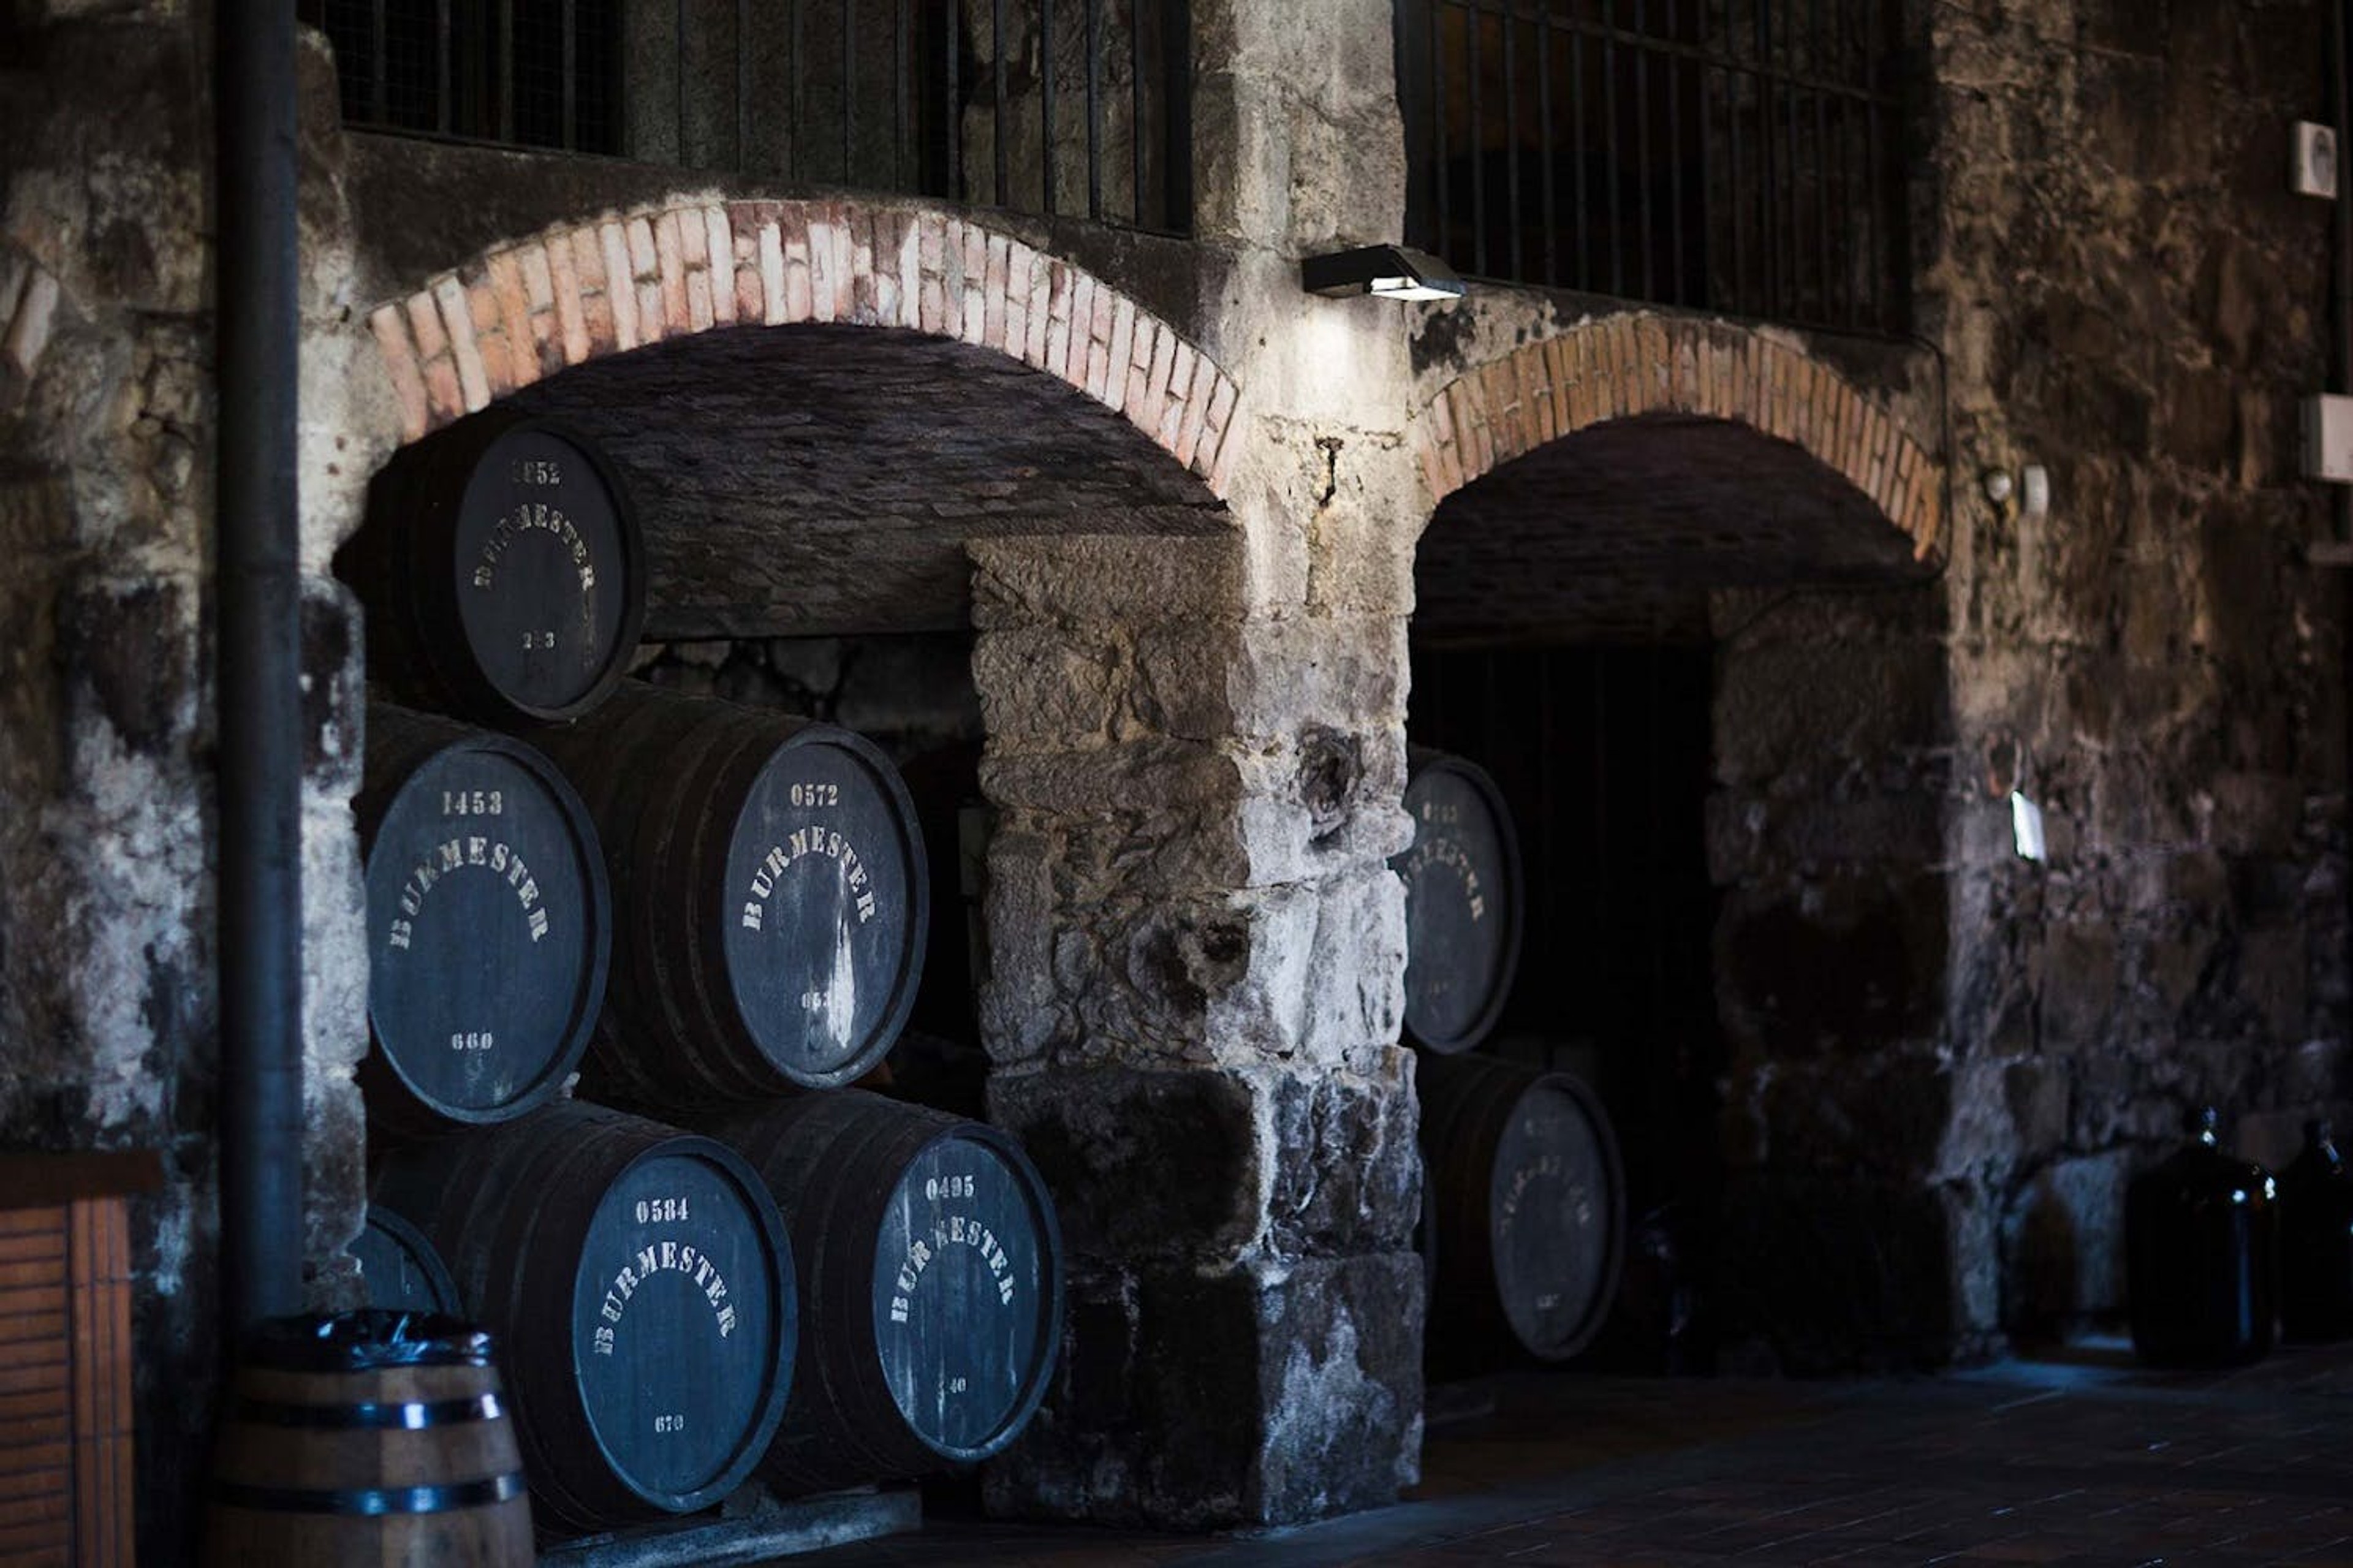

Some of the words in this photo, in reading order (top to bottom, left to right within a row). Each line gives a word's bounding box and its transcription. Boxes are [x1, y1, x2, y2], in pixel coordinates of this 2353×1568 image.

[522, 631, 555, 649] 23
[442, 790, 502, 816] 1453
[790, 784, 839, 807] 0572
[742, 825, 876, 931] BURMESTER
[389, 836, 549, 950] BURMESTER
[451, 1032, 493, 1051] 660
[926, 1175, 975, 1200] 0495
[636, 1197, 689, 1224] 0584
[594, 1241, 737, 1356] BURMESTER
[654, 1414, 684, 1433] 670
